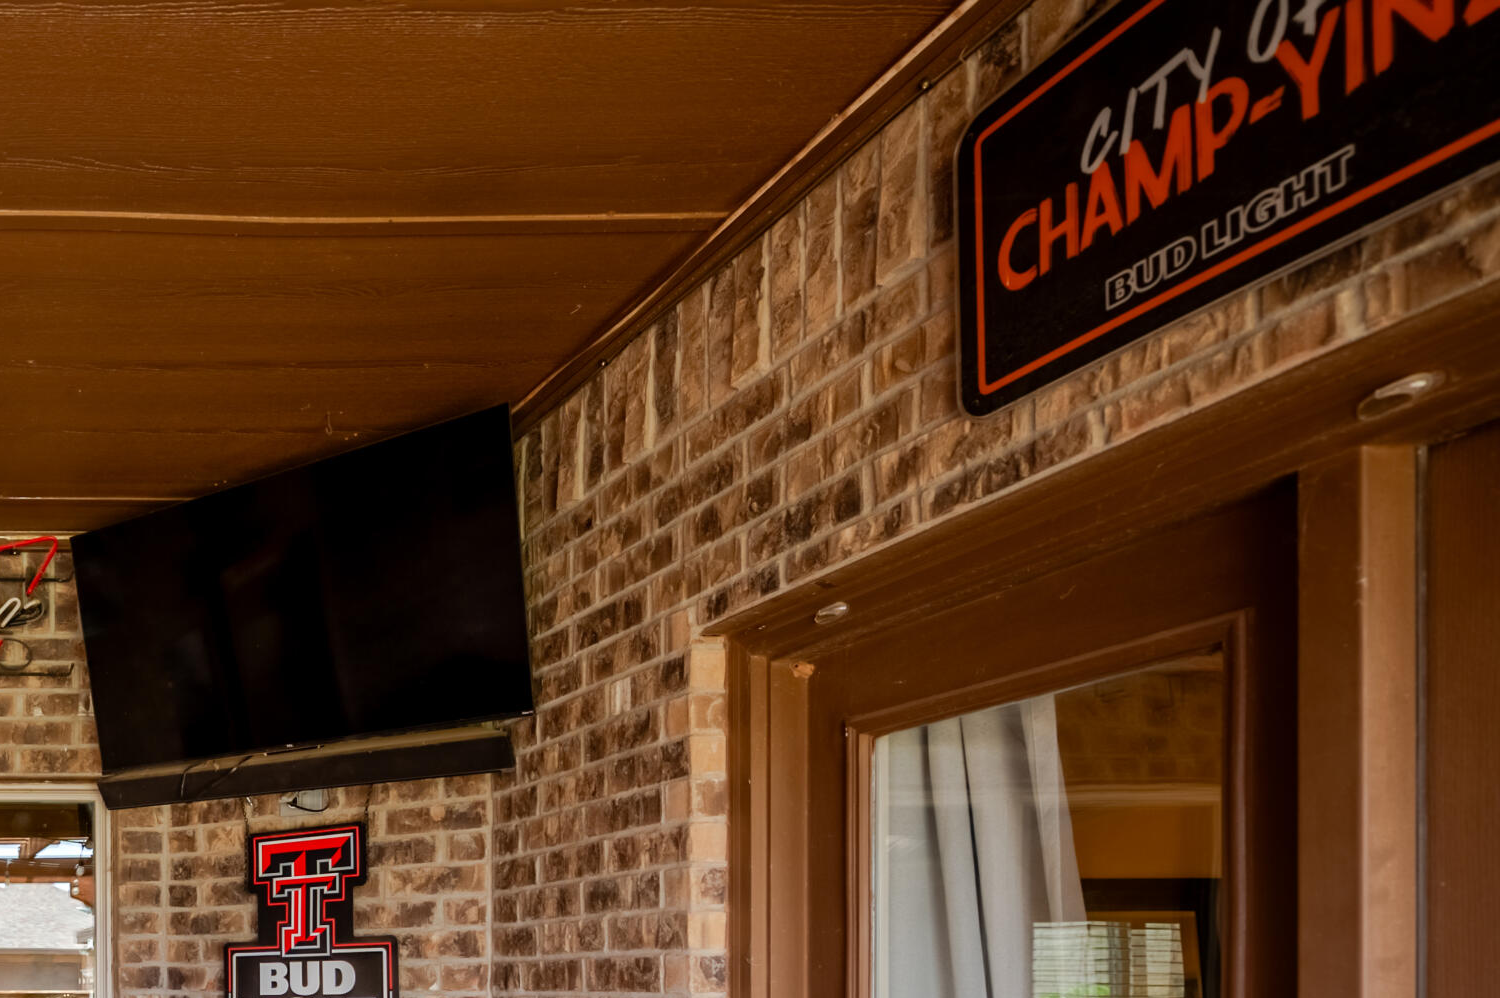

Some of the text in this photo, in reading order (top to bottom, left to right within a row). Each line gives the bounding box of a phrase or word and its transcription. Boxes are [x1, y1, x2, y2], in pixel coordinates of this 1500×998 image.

[999, 0, 1500, 291] CHAMP-YIN
[1081, 0, 1327, 174] CITY O
[1105, 144, 1355, 311] BUD LIGHT
[259, 960, 356, 996] BUD
